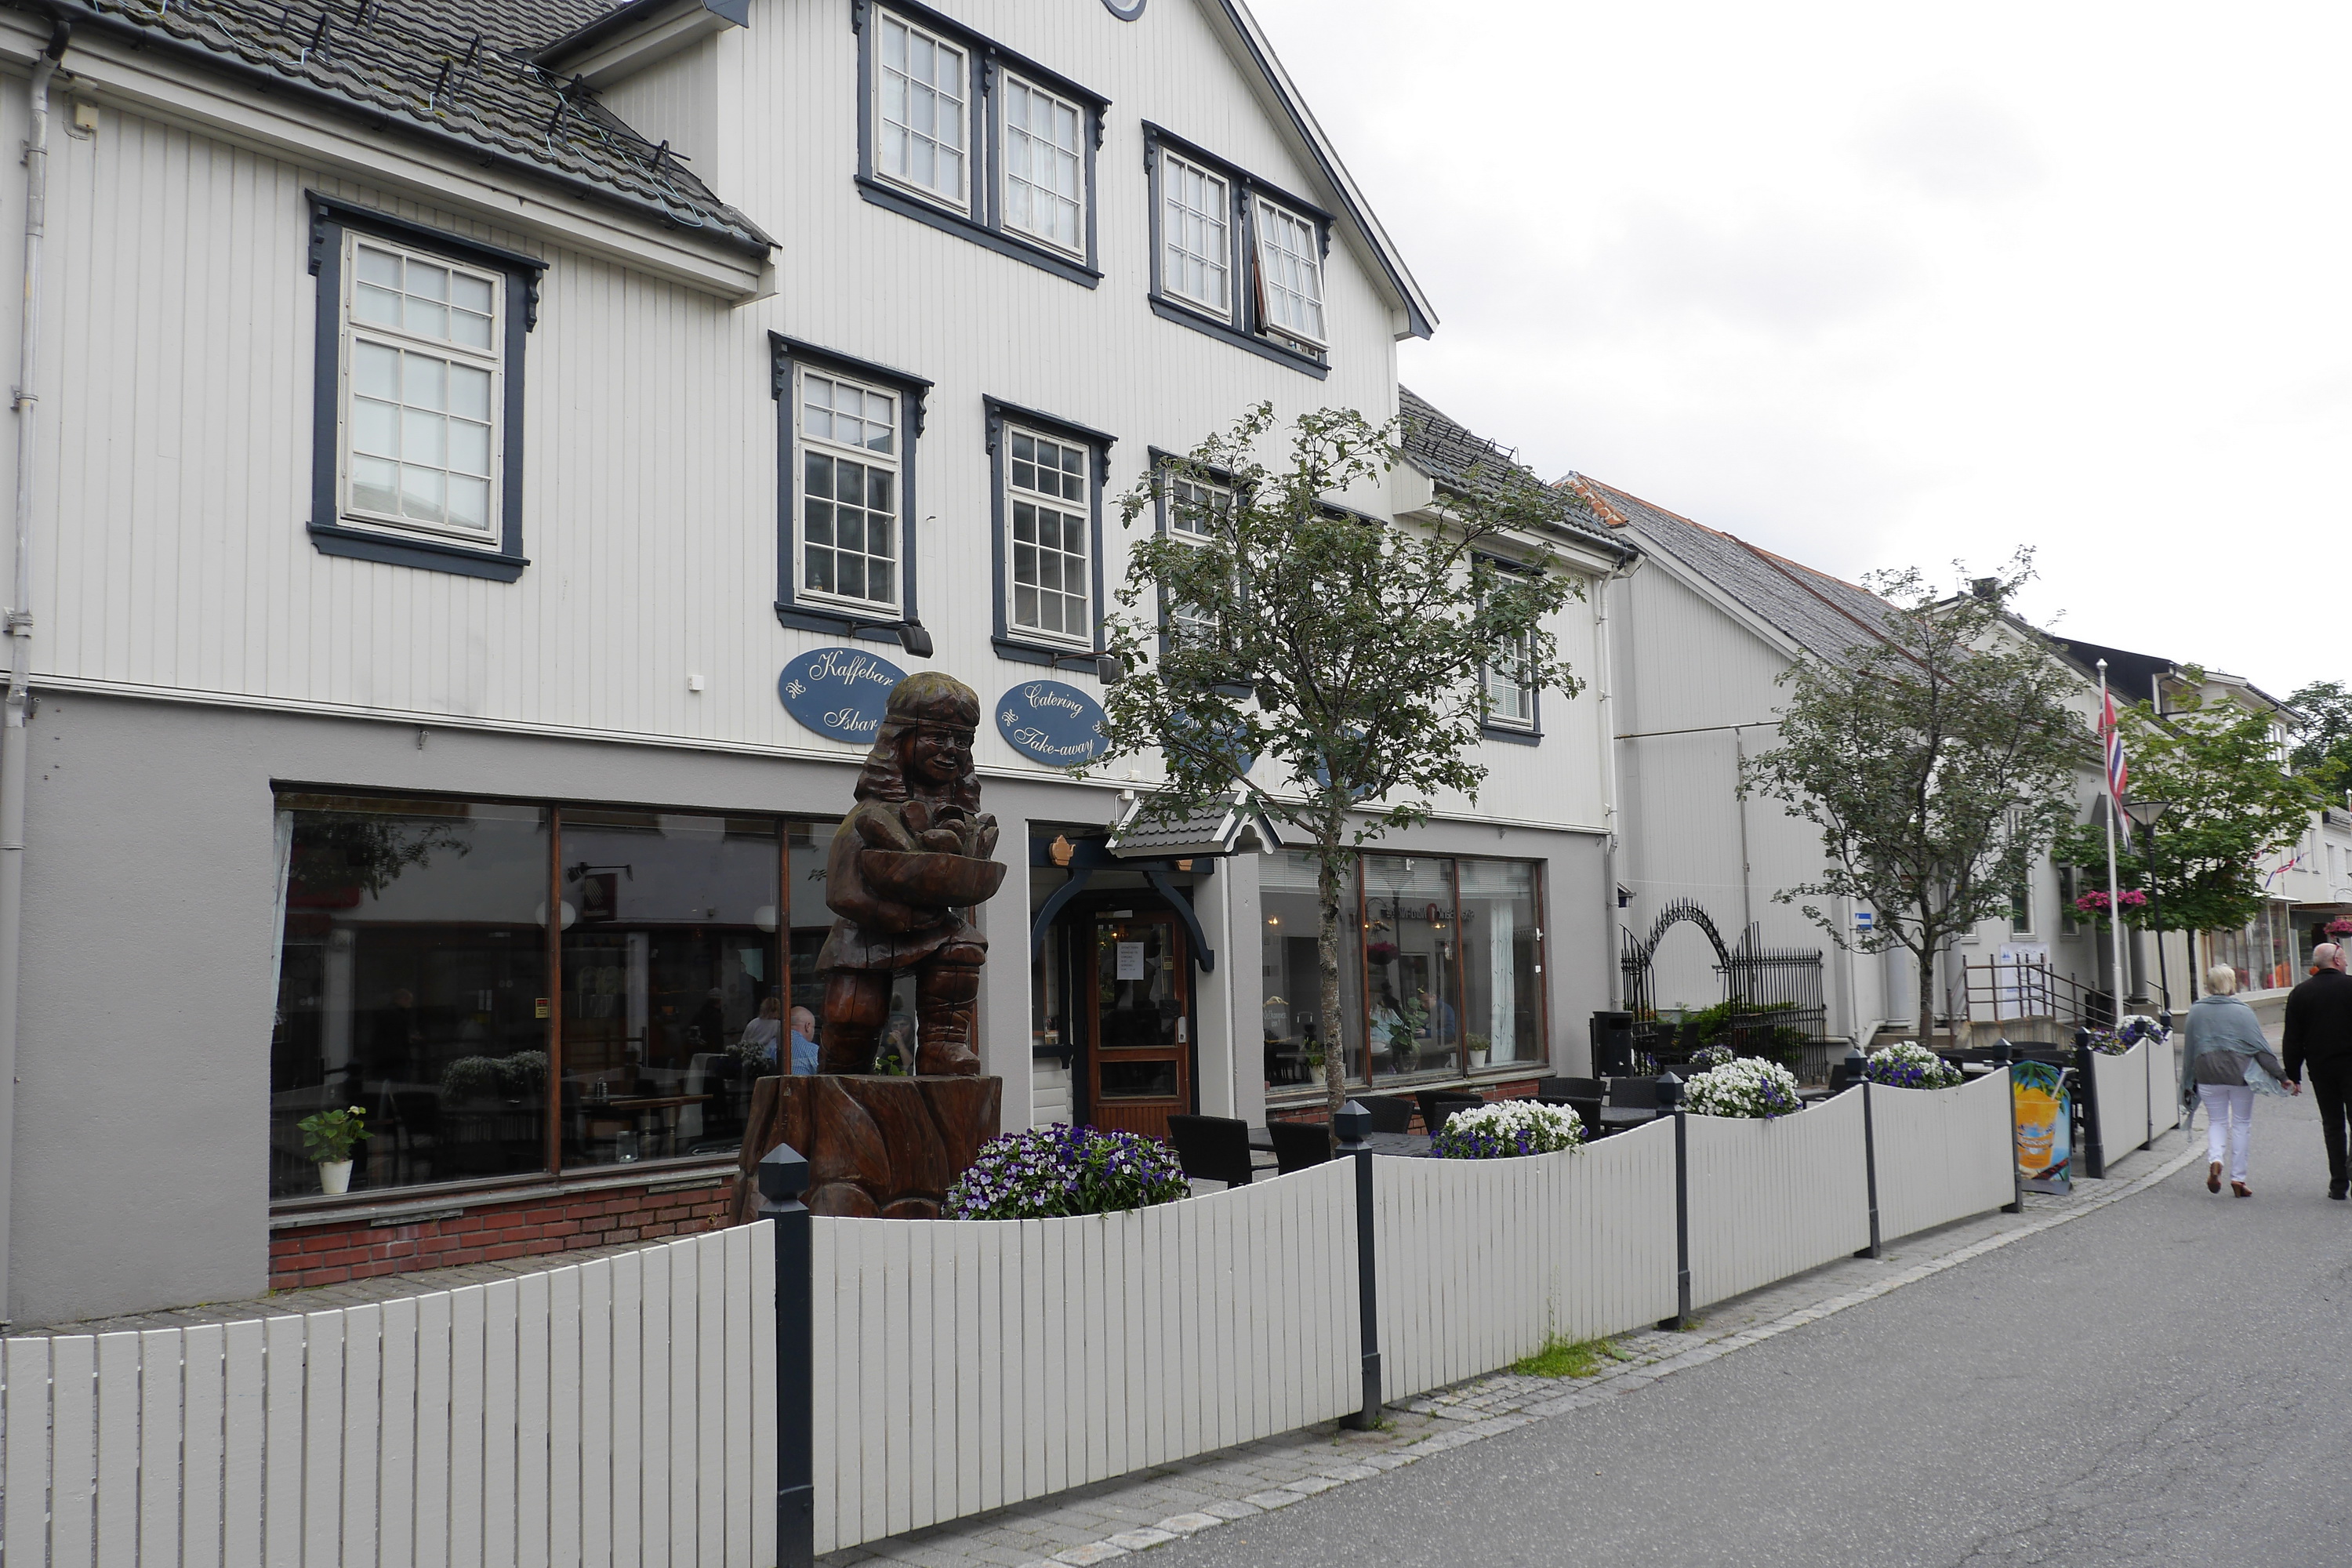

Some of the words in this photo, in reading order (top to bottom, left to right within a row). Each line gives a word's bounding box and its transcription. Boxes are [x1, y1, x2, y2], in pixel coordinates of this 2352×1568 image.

[809, 650, 894, 686] Kaffebar
[1024, 684, 1083, 719] Catering
[823, 707, 878, 731] Isbar
[1014, 727, 1094, 759] Take-away
